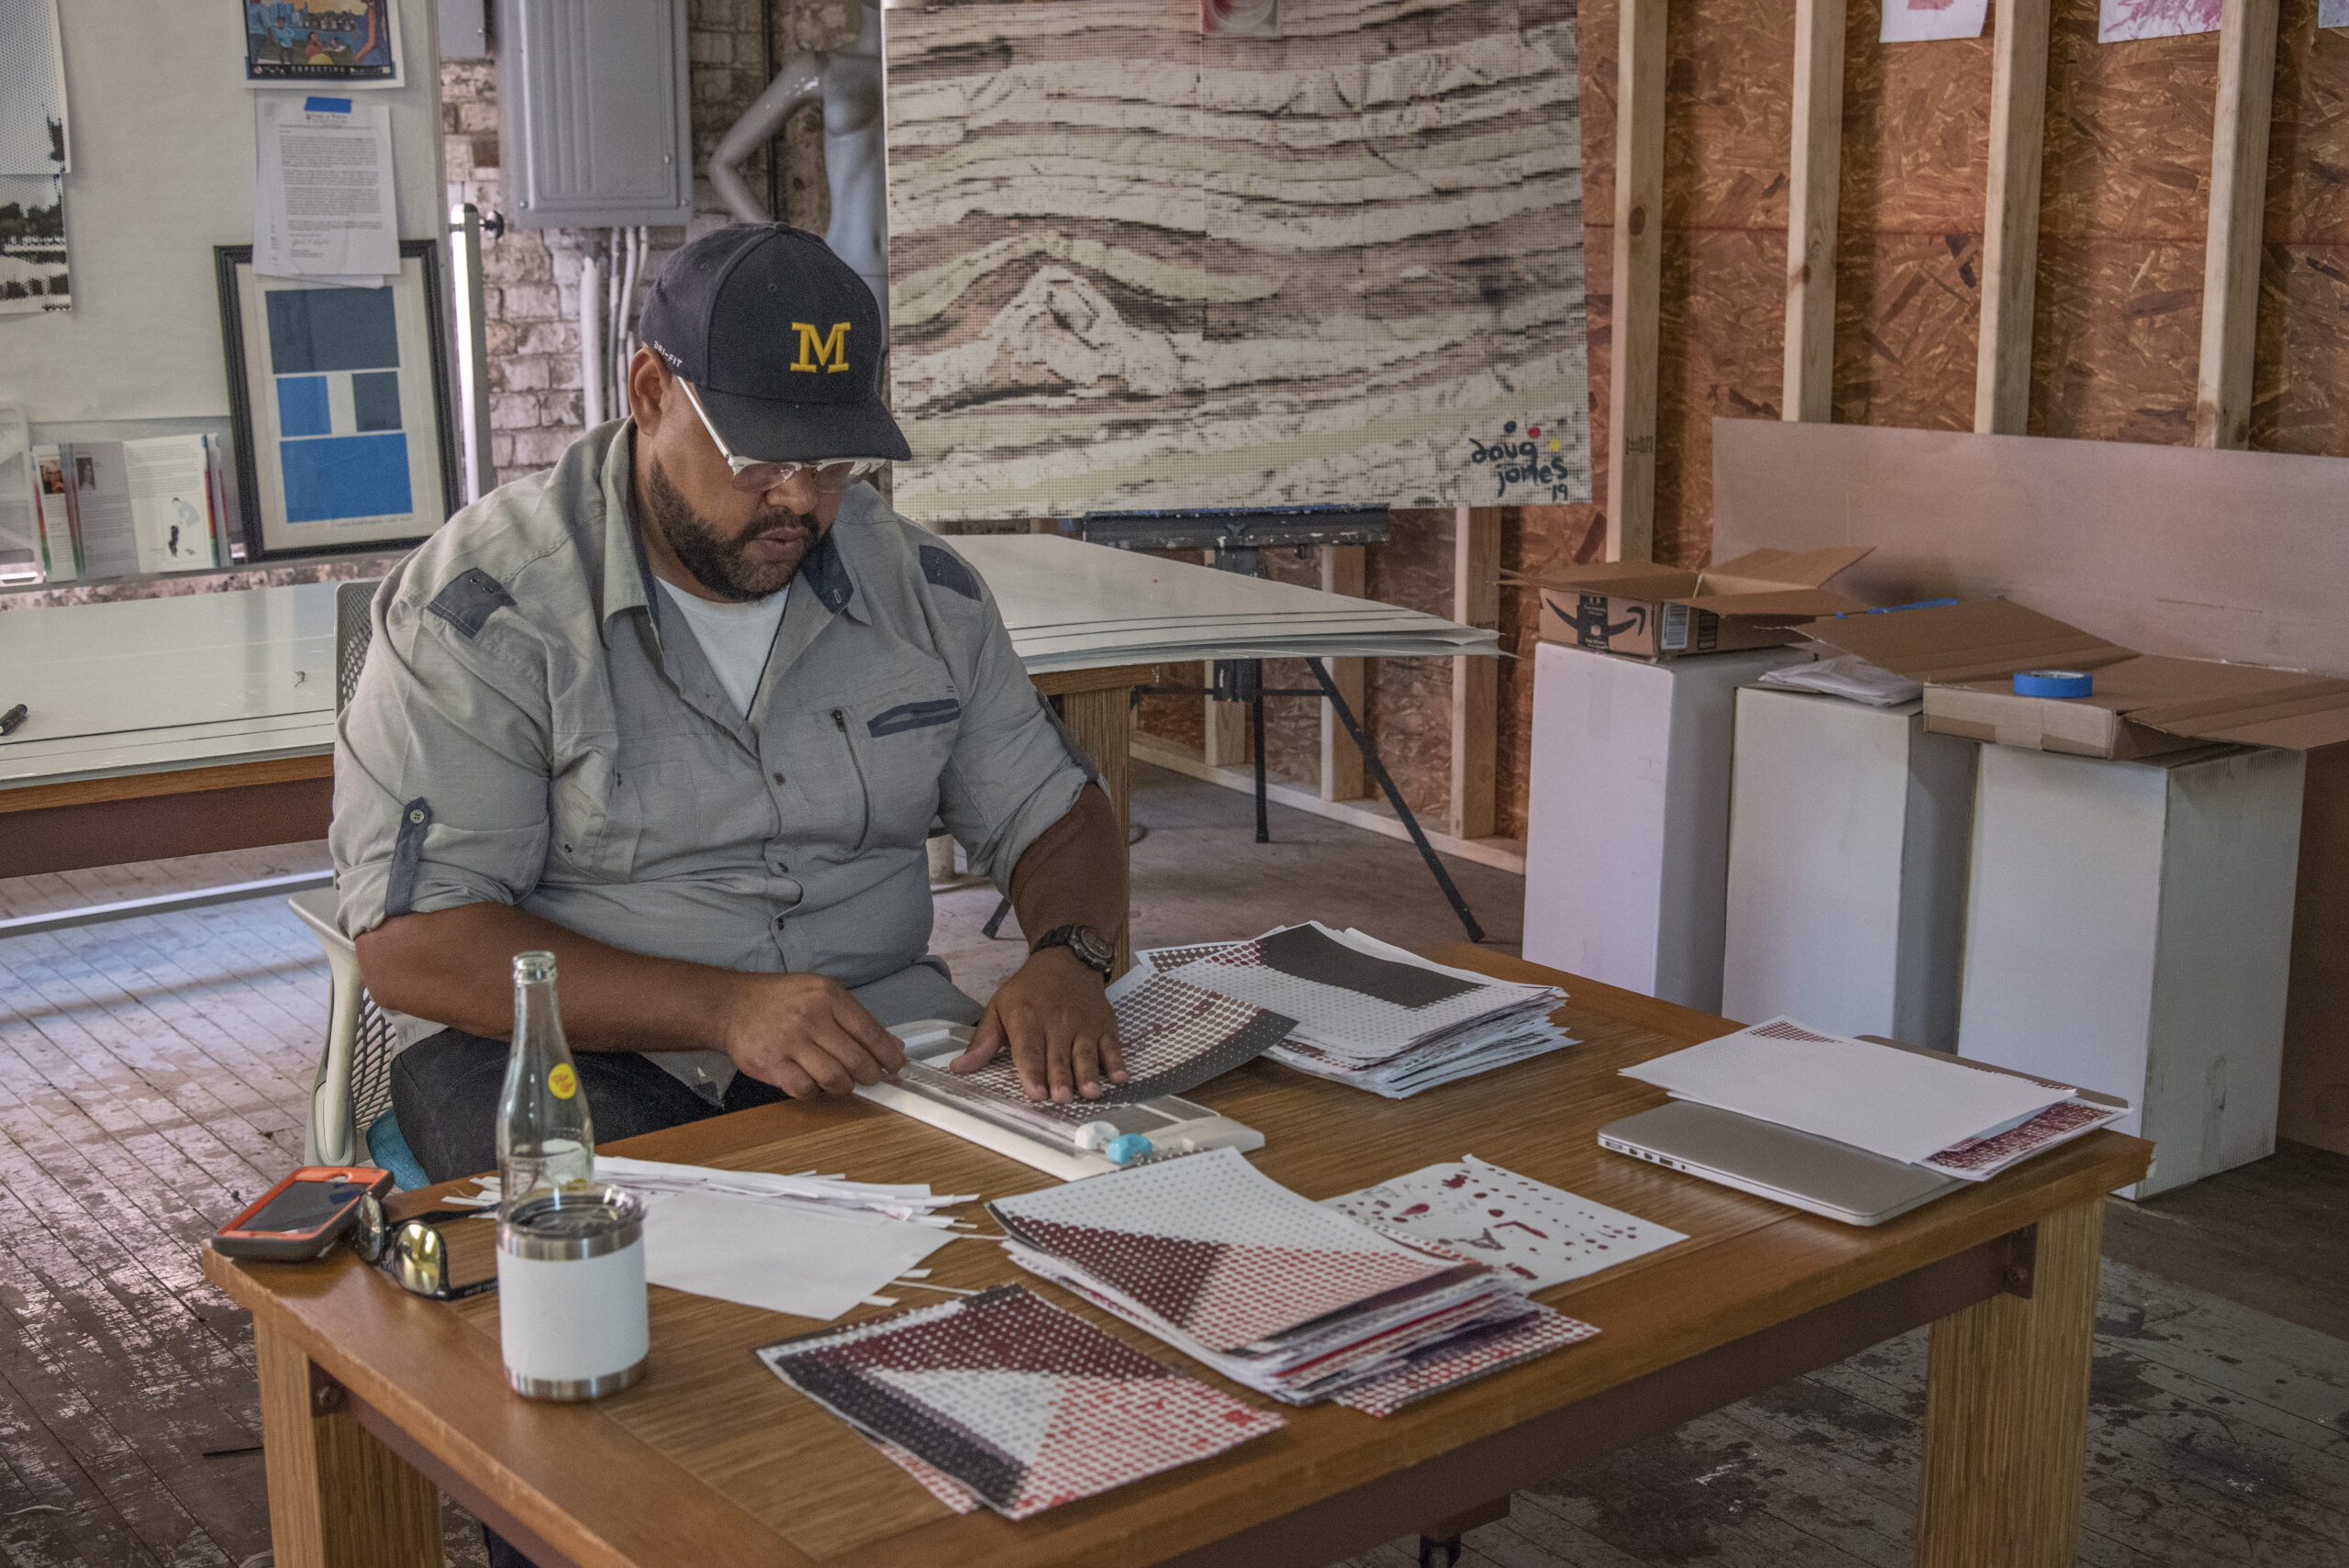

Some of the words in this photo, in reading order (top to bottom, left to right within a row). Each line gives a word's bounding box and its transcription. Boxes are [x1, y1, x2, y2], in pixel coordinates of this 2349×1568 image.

[653, 340, 683, 367] DRI-FIT
[790, 322, 852, 374] M
[1552, 484, 1568, 502] 19
